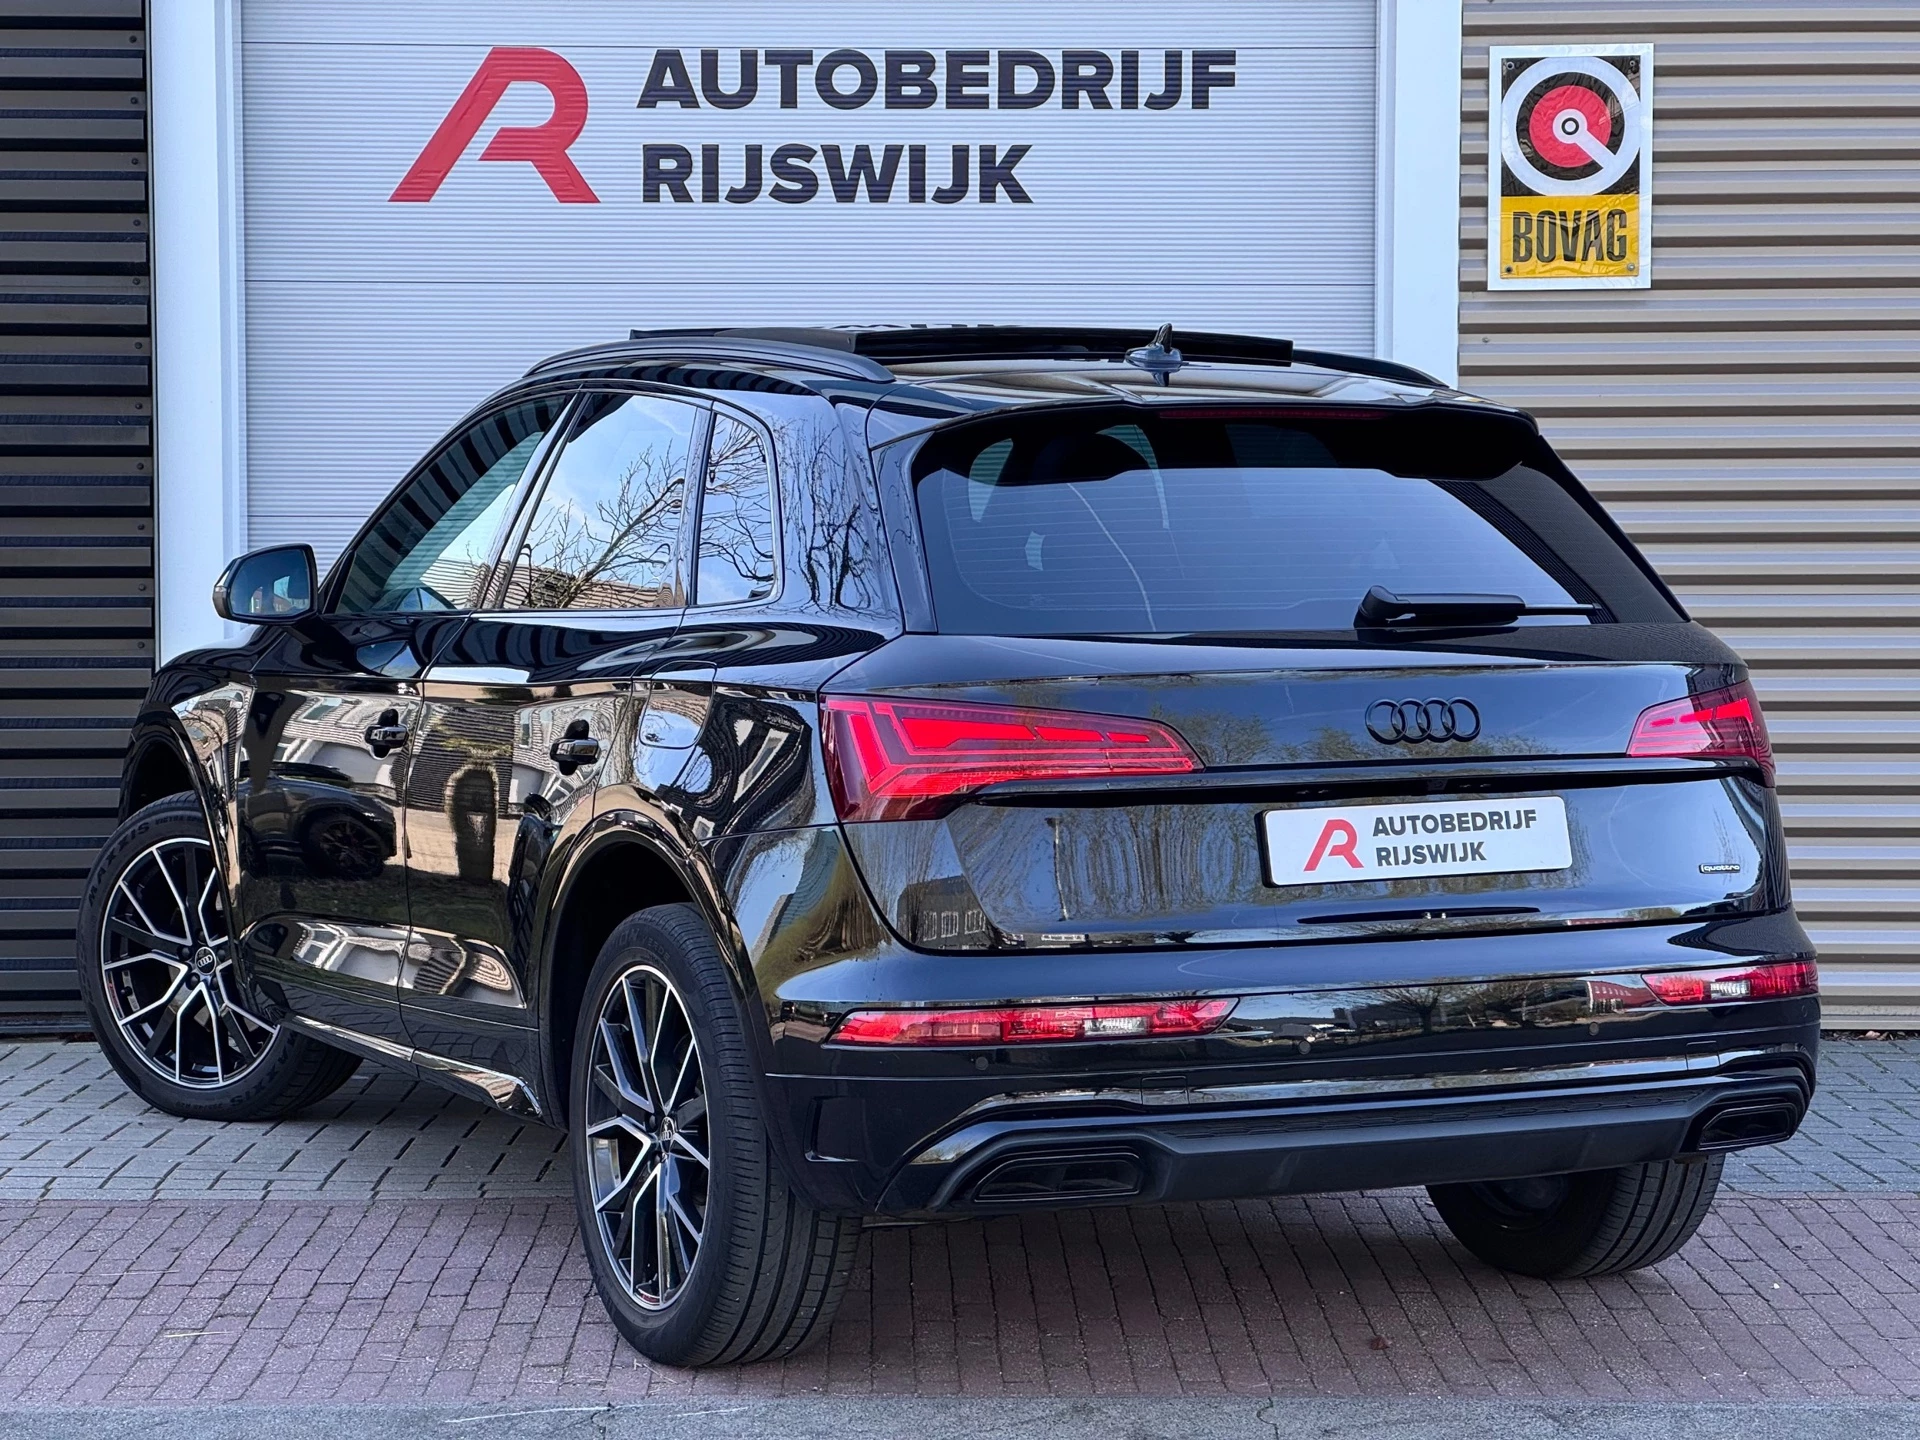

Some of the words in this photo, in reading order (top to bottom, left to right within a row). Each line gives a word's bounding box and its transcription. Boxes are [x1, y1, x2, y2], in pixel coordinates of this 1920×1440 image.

[637, 50, 1236, 110] AUTOBEDRIJF
[643, 144, 1033, 204] RIJSWIJK
[1512, 209, 1627, 263] BOVAG
[1372, 809, 1537, 837] AUTOBEDRIJF
[1376, 841, 1487, 866] RIJSWIJK
[1702, 864, 1740, 872] quattro
